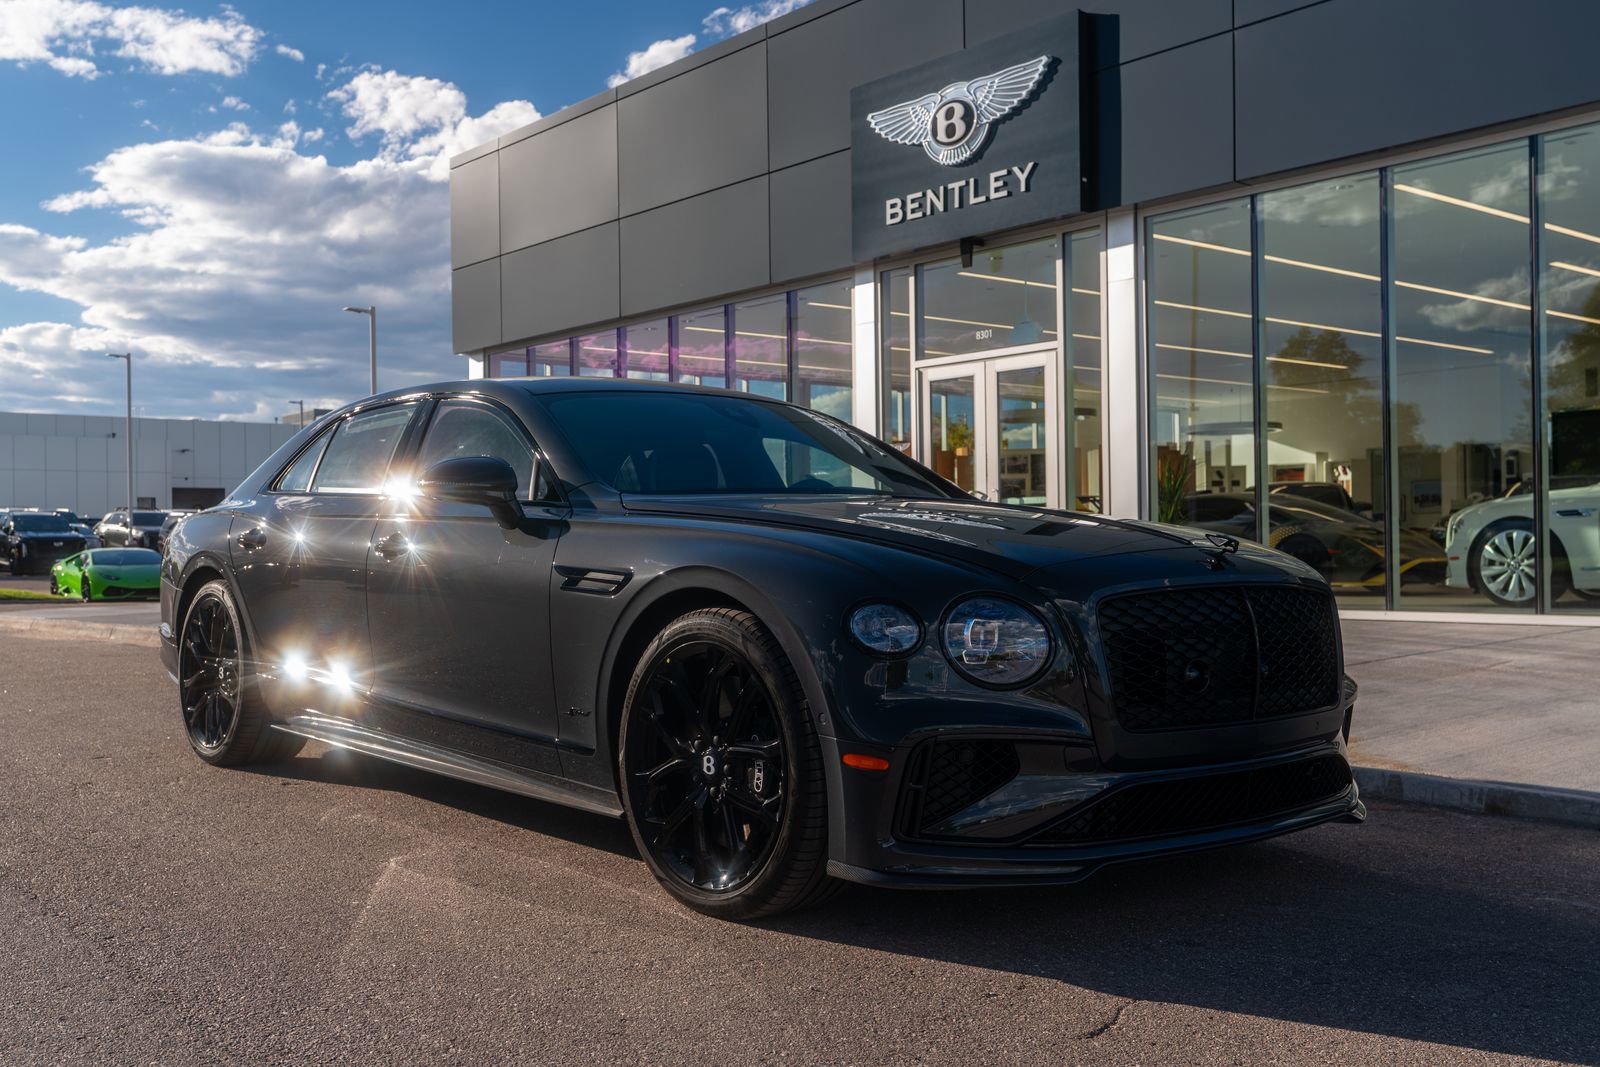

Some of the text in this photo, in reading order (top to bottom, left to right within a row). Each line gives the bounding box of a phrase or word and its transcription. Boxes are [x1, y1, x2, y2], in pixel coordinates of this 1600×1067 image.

[936, 102, 966, 143] B
[885, 161, 1036, 225] BENTLEY
[976, 329, 992, 340] 8301
[702, 755, 716, 775] B
